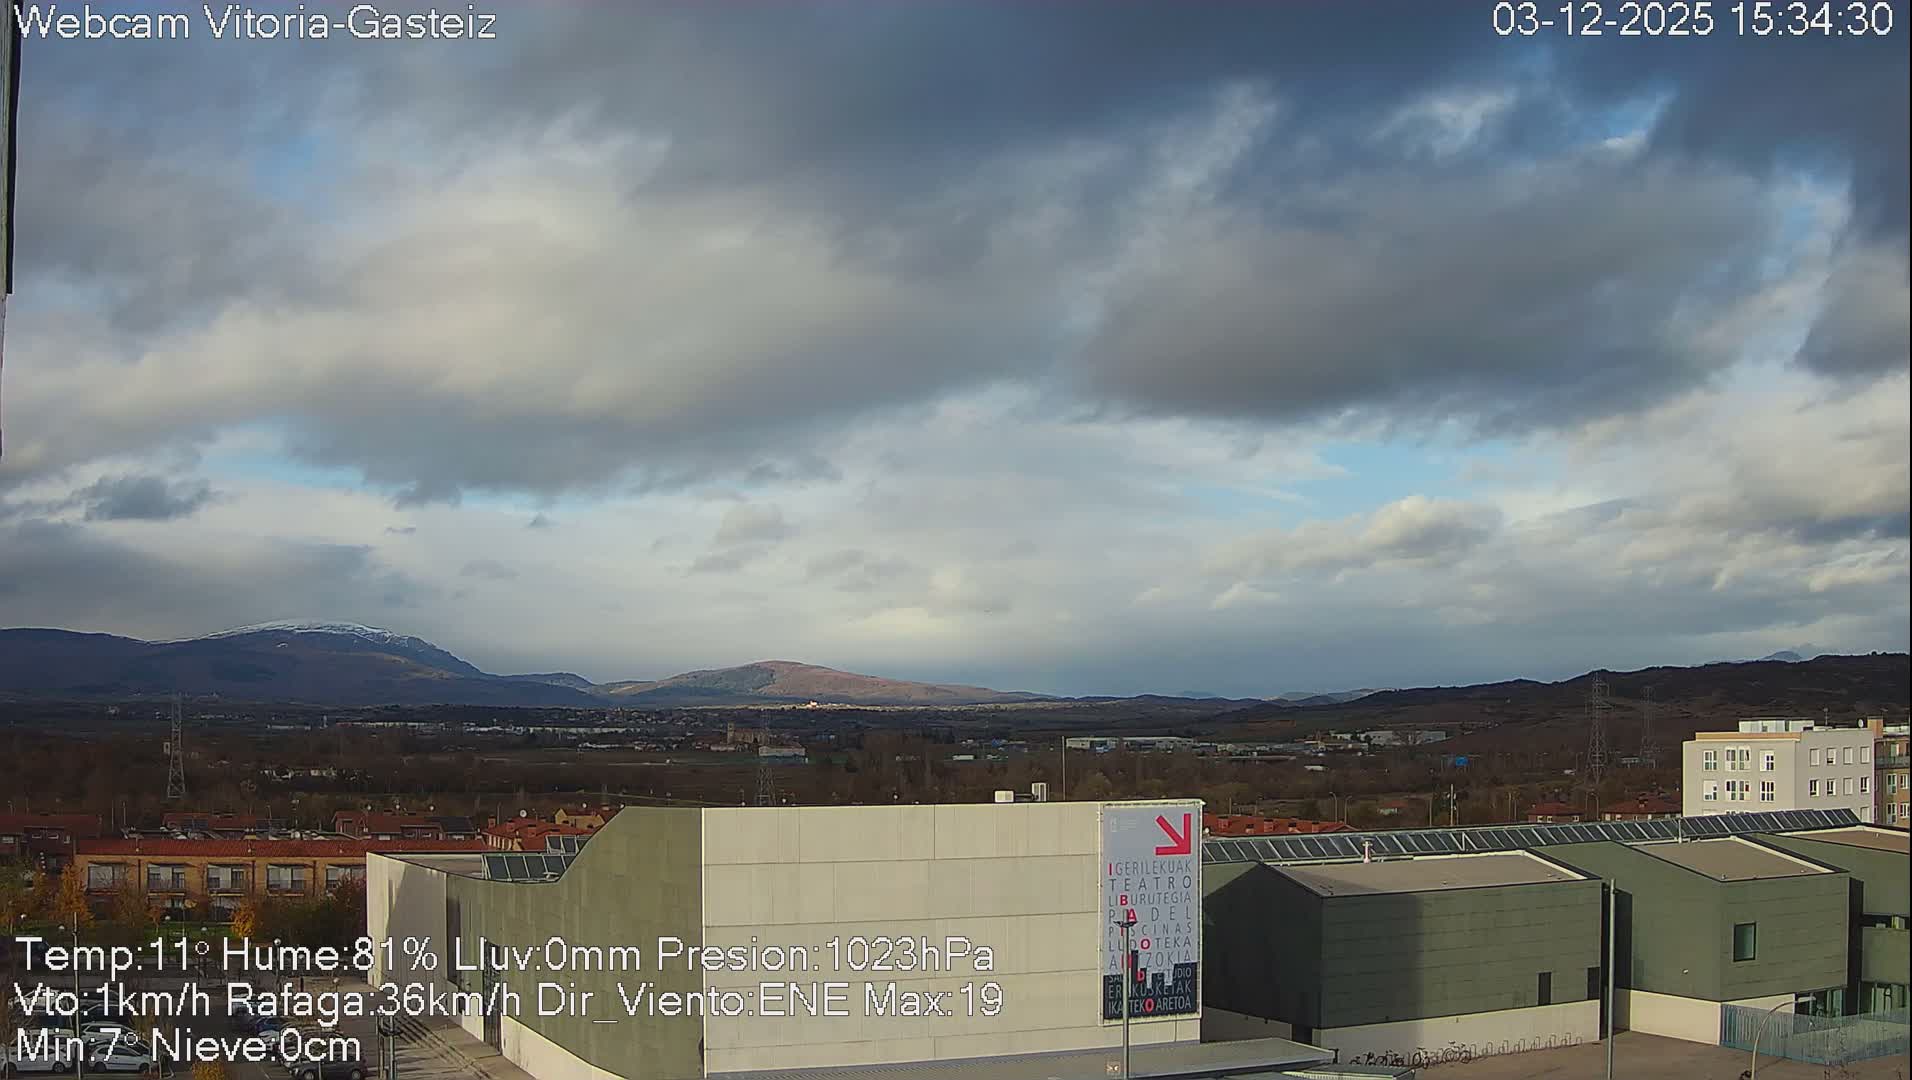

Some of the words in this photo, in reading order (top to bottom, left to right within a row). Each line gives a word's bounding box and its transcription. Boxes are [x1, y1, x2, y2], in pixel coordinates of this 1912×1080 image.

[1108, 859, 1192, 876] IGERILEKUAK
[1108, 875, 1192, 891] TEATRO
[1108, 891, 1192, 907] LIBURUTEGIA
[1108, 922, 1192, 937] PISCINAS
[1108, 936, 1192, 952] LUDOTEKA
[1157, 967, 1192, 980] ETUDIO
[1108, 980, 1192, 999] ERKUSKETAK
[1108, 998, 1155, 1016] IKATEKO
[1155, 995, 1192, 1013] ARETOA
